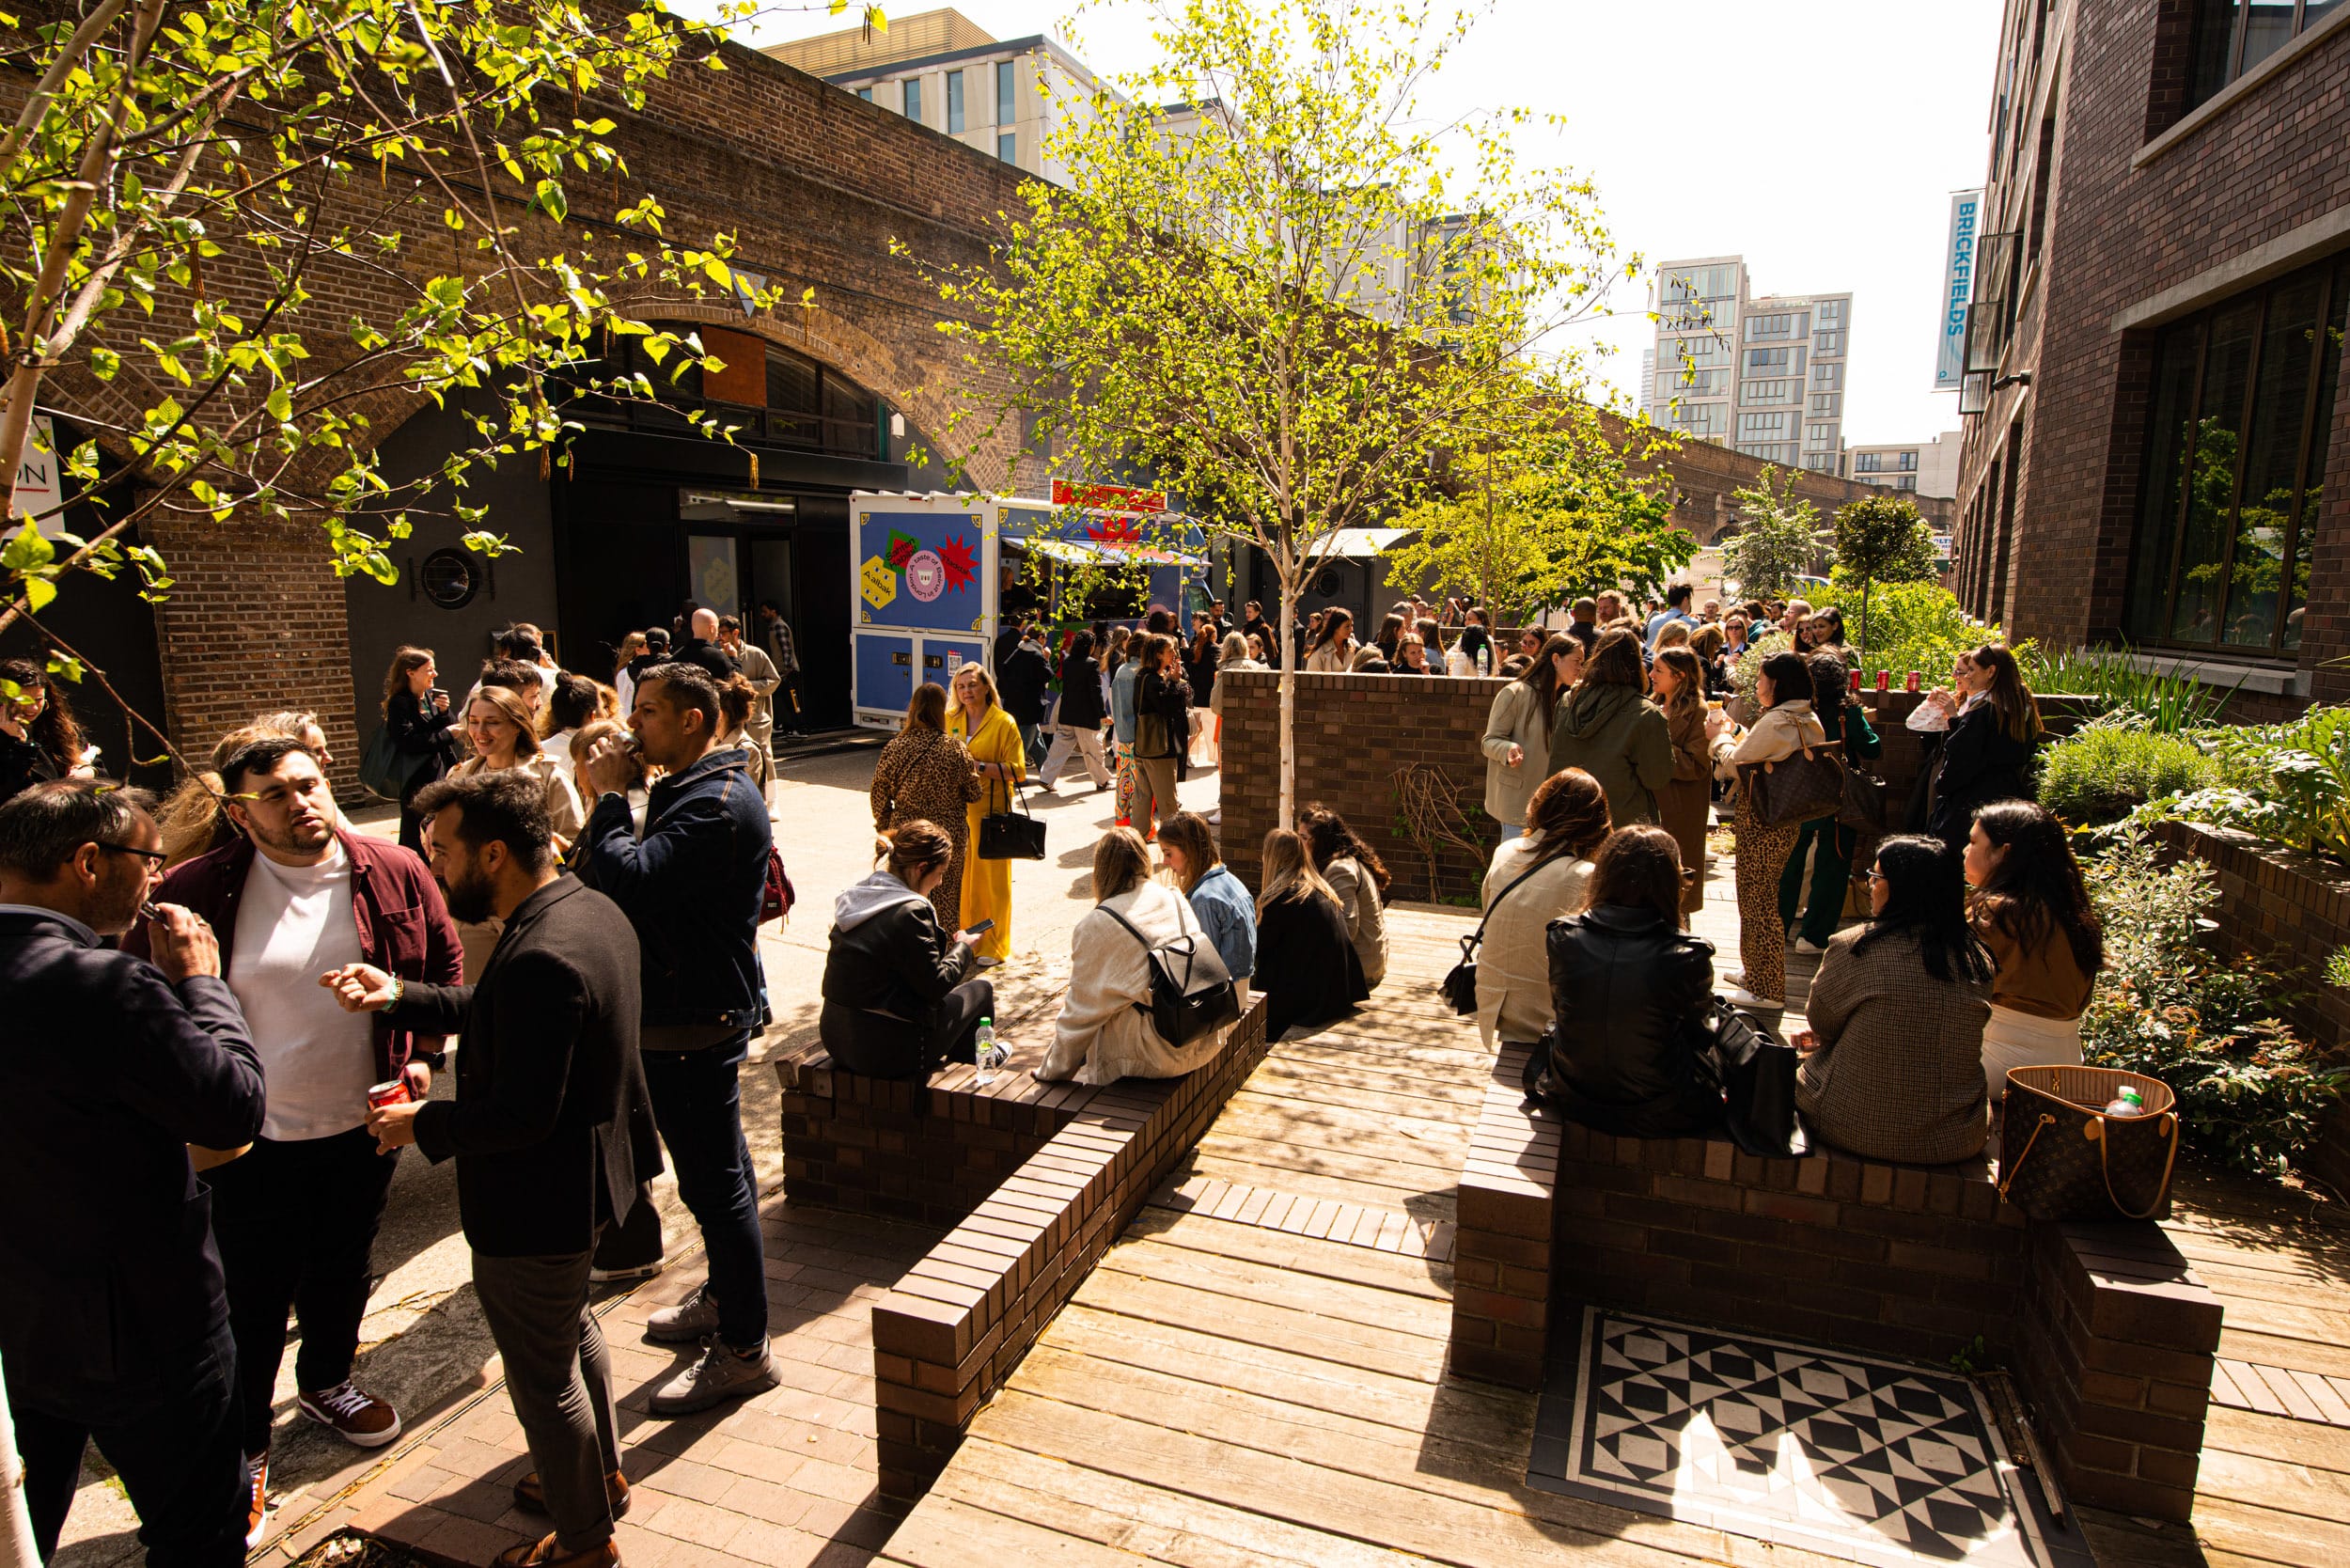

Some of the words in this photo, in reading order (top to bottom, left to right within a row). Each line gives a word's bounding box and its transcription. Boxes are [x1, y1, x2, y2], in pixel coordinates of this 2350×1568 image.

[1948, 202, 1976, 337] BRICKFIELDS
[914, 554, 931, 564] taste
[909, 573, 927, 599] London
[933, 566, 942, 592] Beirut
